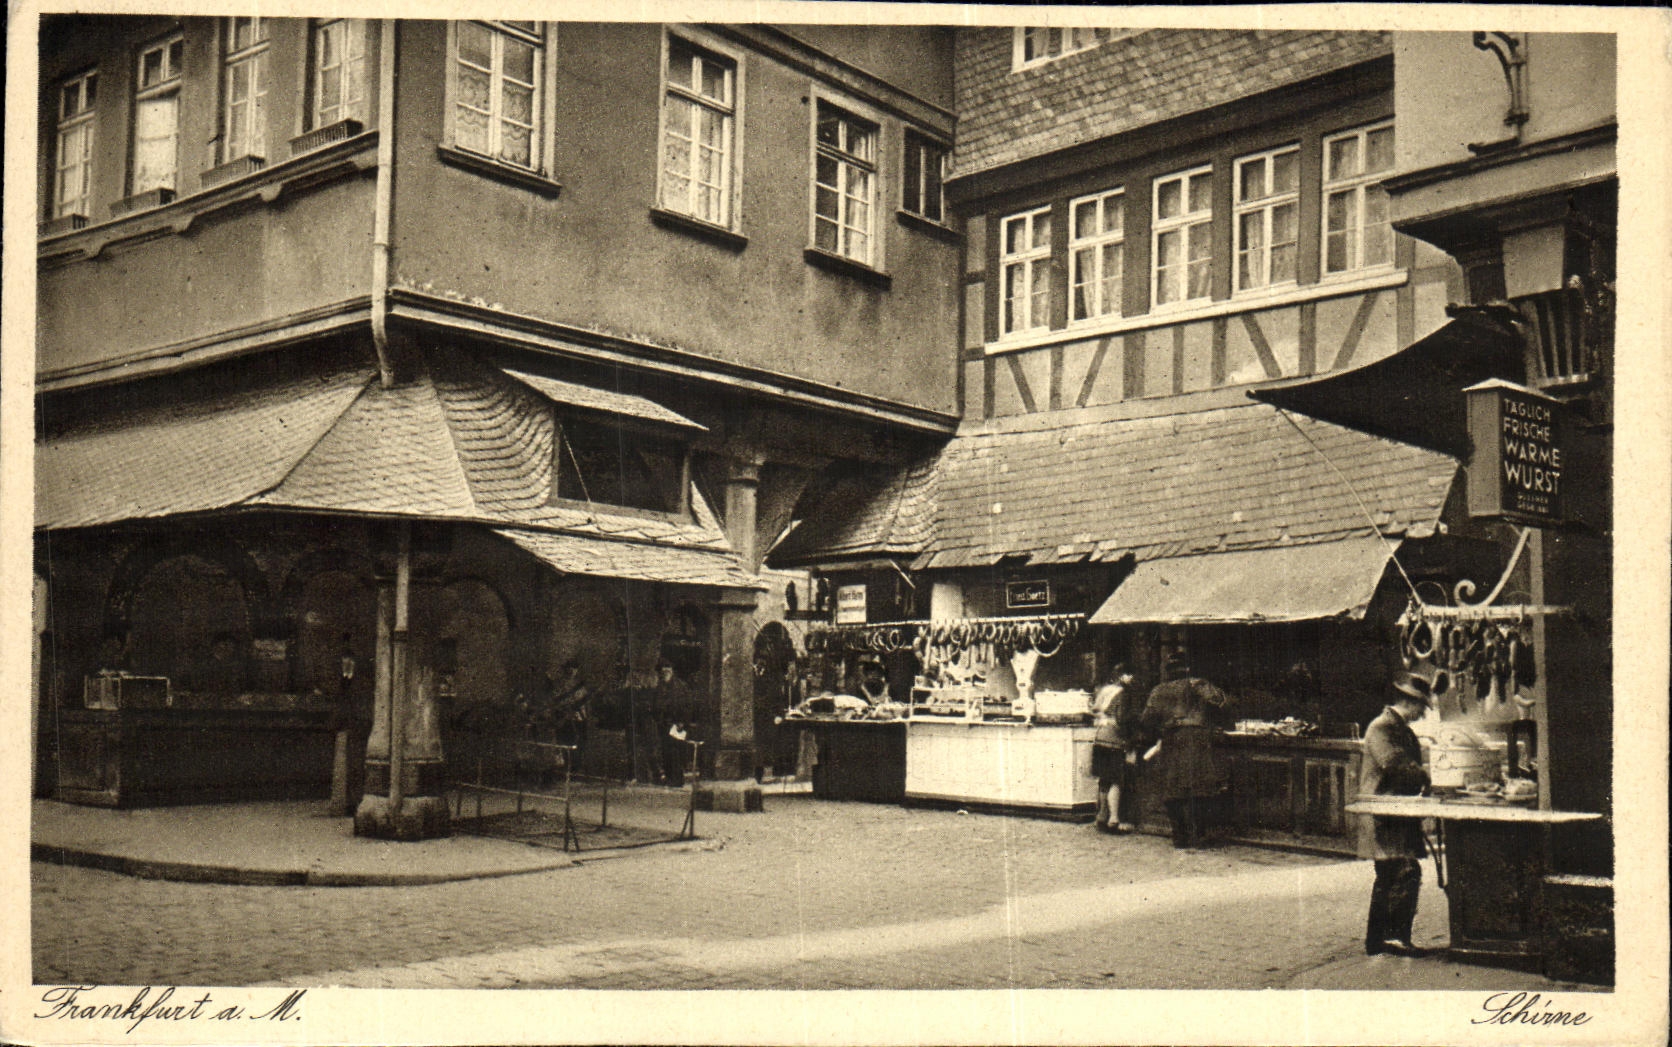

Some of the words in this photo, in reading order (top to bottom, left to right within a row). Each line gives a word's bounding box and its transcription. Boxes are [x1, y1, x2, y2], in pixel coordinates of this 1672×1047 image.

[1503, 416, 1550, 442] FRISCHE
[1504, 436, 1560, 467] WARME
[1504, 460, 1560, 495] WURST
